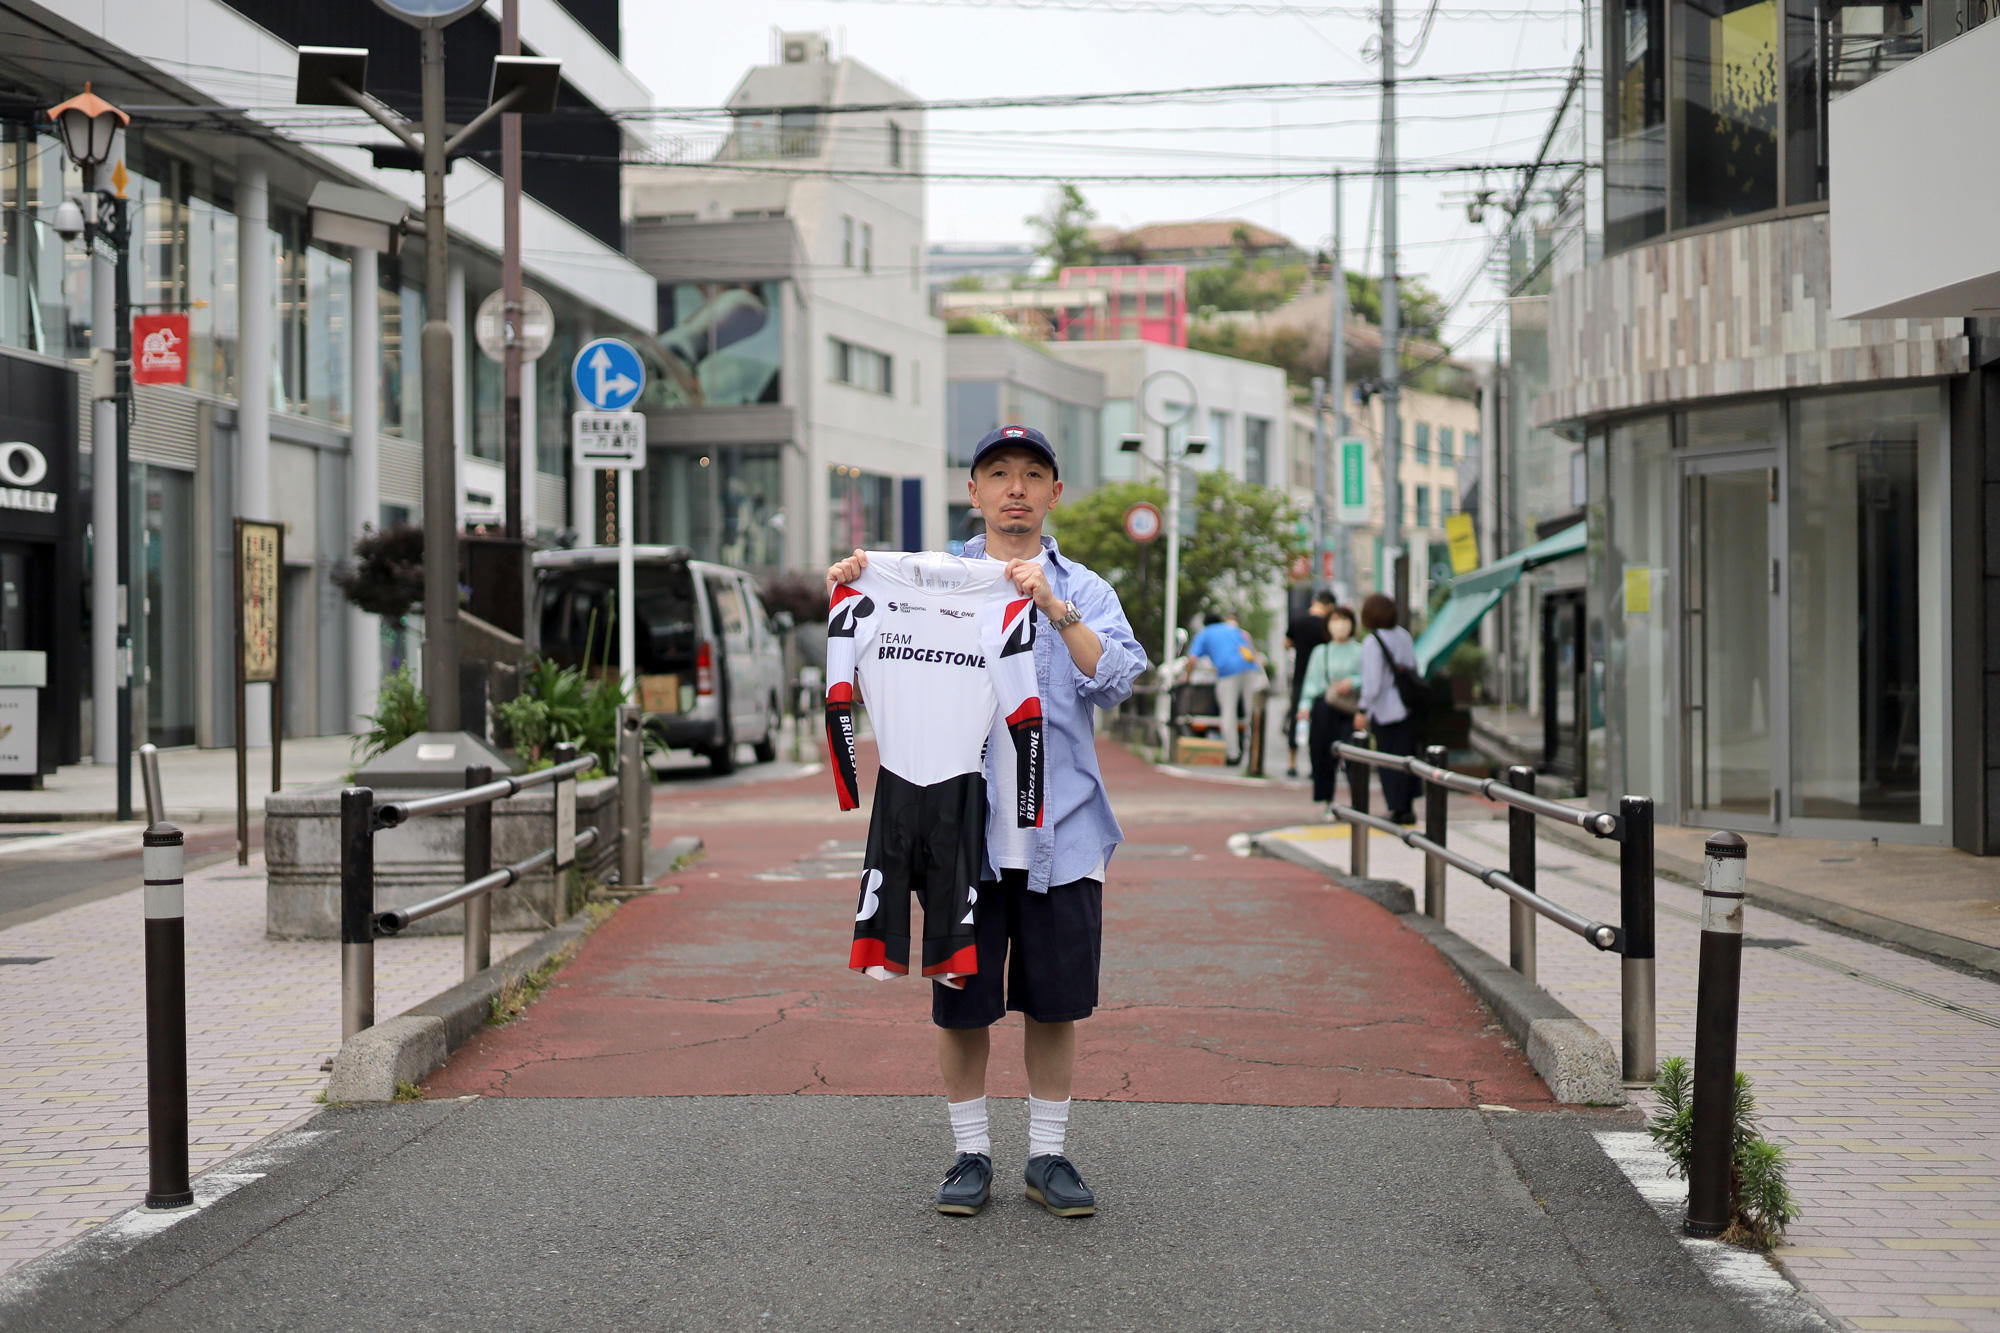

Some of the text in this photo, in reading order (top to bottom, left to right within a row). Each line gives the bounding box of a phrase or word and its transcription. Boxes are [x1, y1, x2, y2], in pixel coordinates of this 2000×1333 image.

[939, 608, 959, 616] WAVE
[880, 632, 912, 645] TEAM
[878, 646, 986, 669] BRIDGESTONE
[1026, 730, 1040, 821] BRIDGESTONE
[1019, 790, 1028, 817] TEAM
